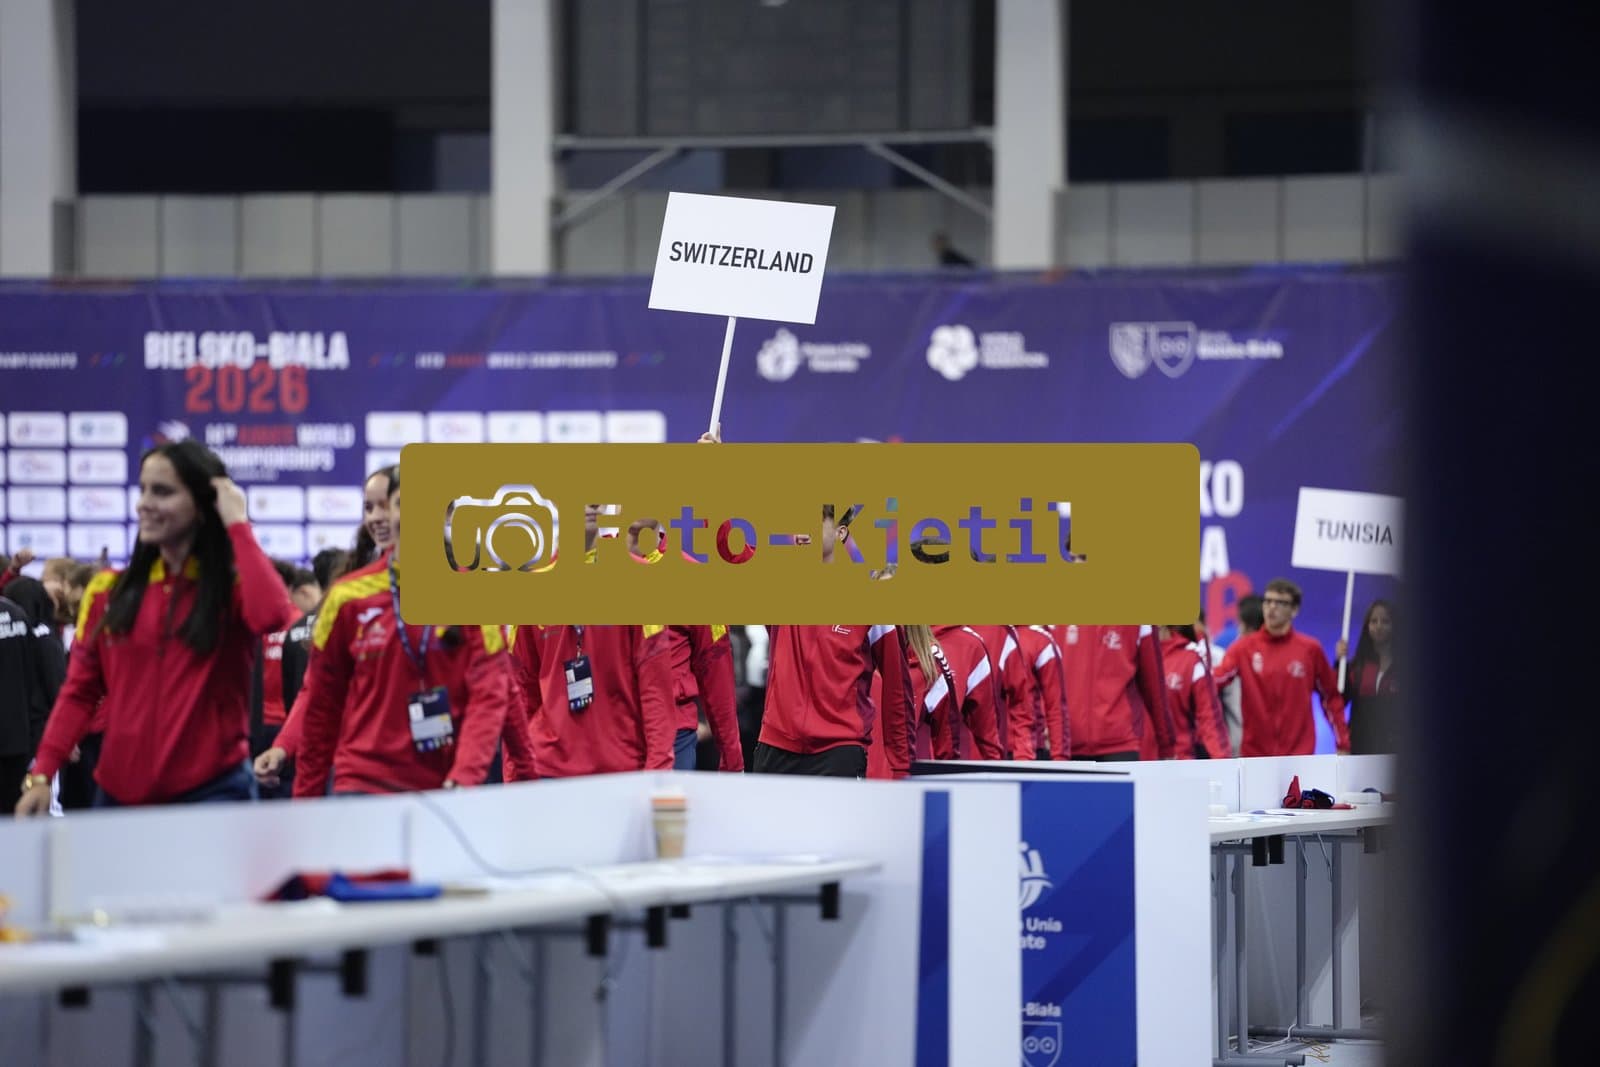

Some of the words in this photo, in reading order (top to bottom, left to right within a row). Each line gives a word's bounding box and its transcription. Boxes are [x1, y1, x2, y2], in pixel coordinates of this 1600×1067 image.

[669, 241, 814, 274] SWITZERLAND
[185, 362, 309, 413] 2026
[1316, 518, 1393, 545] TUNISIA
